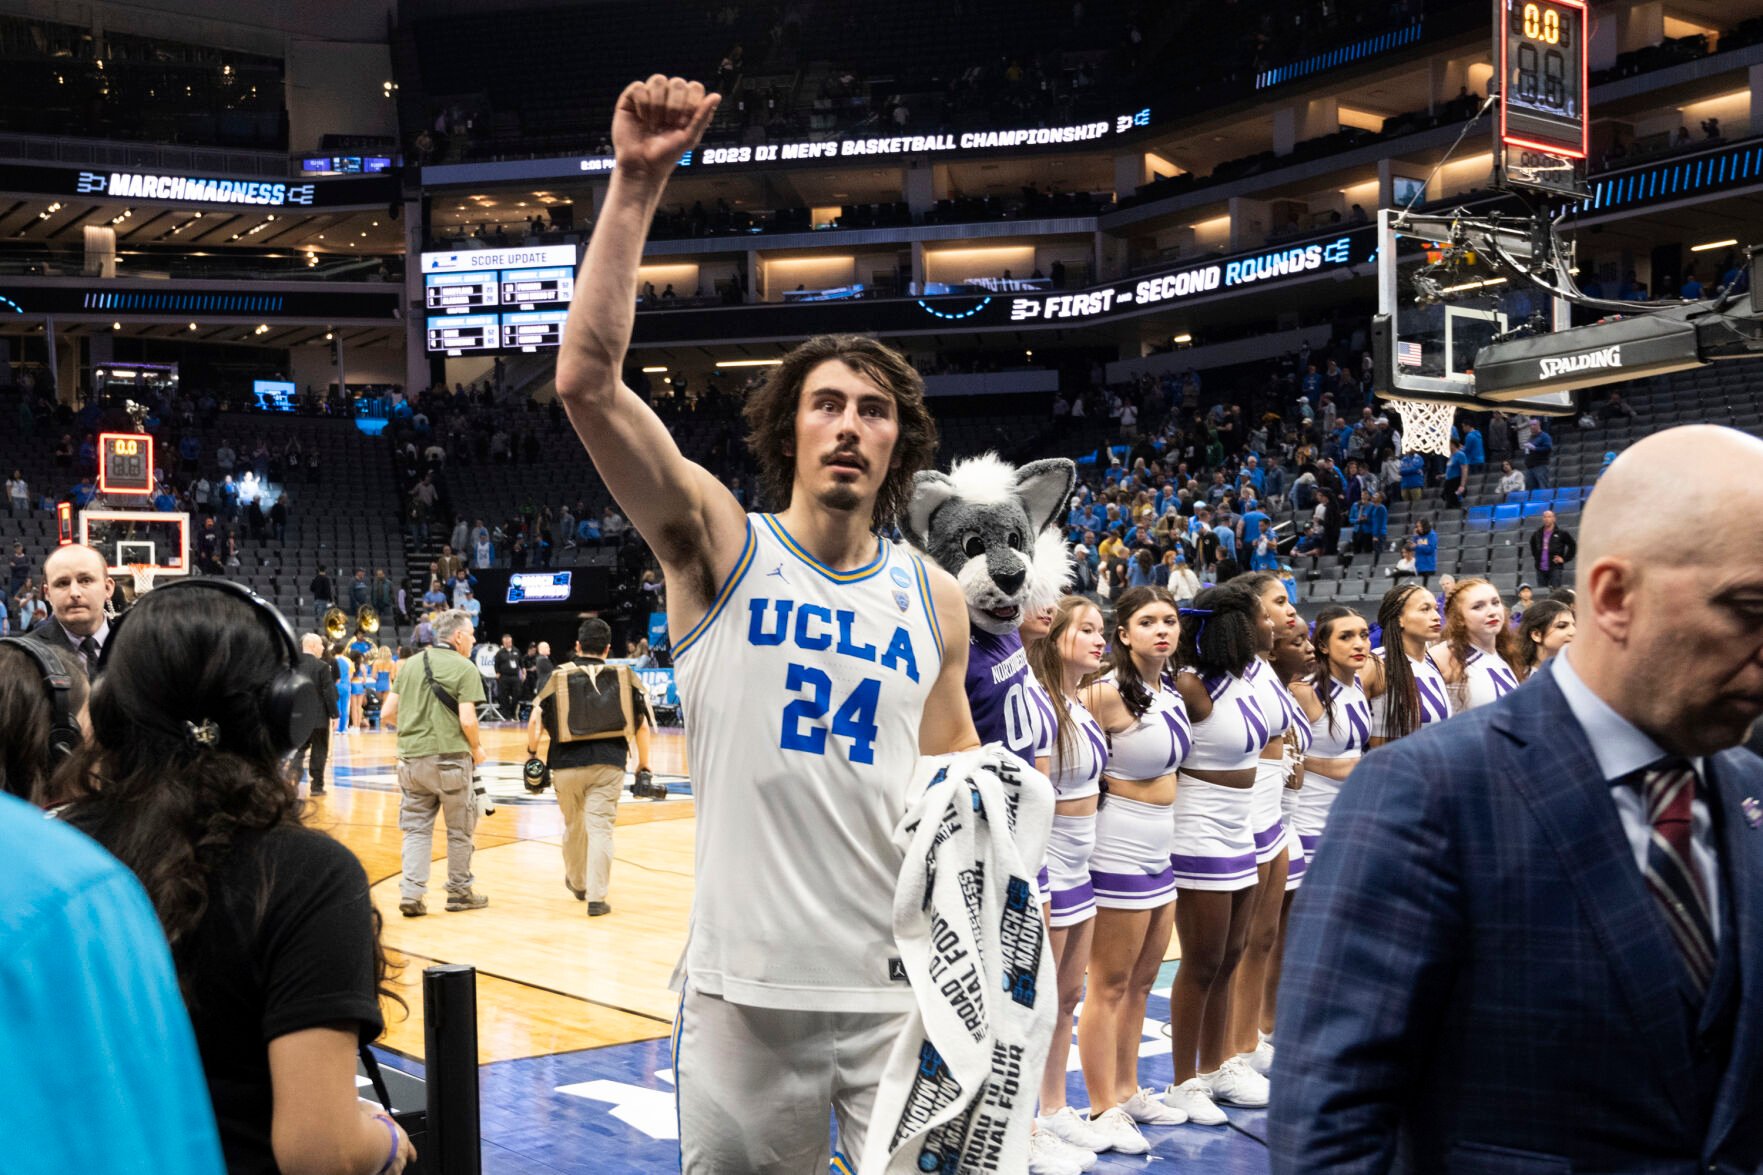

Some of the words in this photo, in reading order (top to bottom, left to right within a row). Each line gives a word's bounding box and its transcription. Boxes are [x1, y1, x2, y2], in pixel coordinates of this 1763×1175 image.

[1524, 3, 1559, 45] 0.0
[702, 147, 752, 165] 2023
[755, 145, 777, 162] DI
[781, 142, 837, 160] MEN'S
[841, 134, 957, 156] BASKETBALL
[960, 121, 1109, 149] CHAMPIONSHIP
[108, 173, 286, 206] MARCHMADNESS
[471, 254, 505, 266] SCORE
[508, 252, 548, 264] UPDATE
[1044, 288, 1116, 319] FIRST
[1135, 266, 1221, 304] SECOND
[1225, 244, 1323, 287] ROUNDS
[1539, 344, 1623, 380] SPALDING
[115, 439, 138, 455] 0.0
[748, 597, 921, 685] UCLA
[780, 662, 882, 766] 24
[1001, 906, 1027, 976] MARCH
[940, 977, 982, 1033] ROAD
[980, 1114, 1011, 1175] INAL
[998, 1043, 1026, 1110] FOUR
